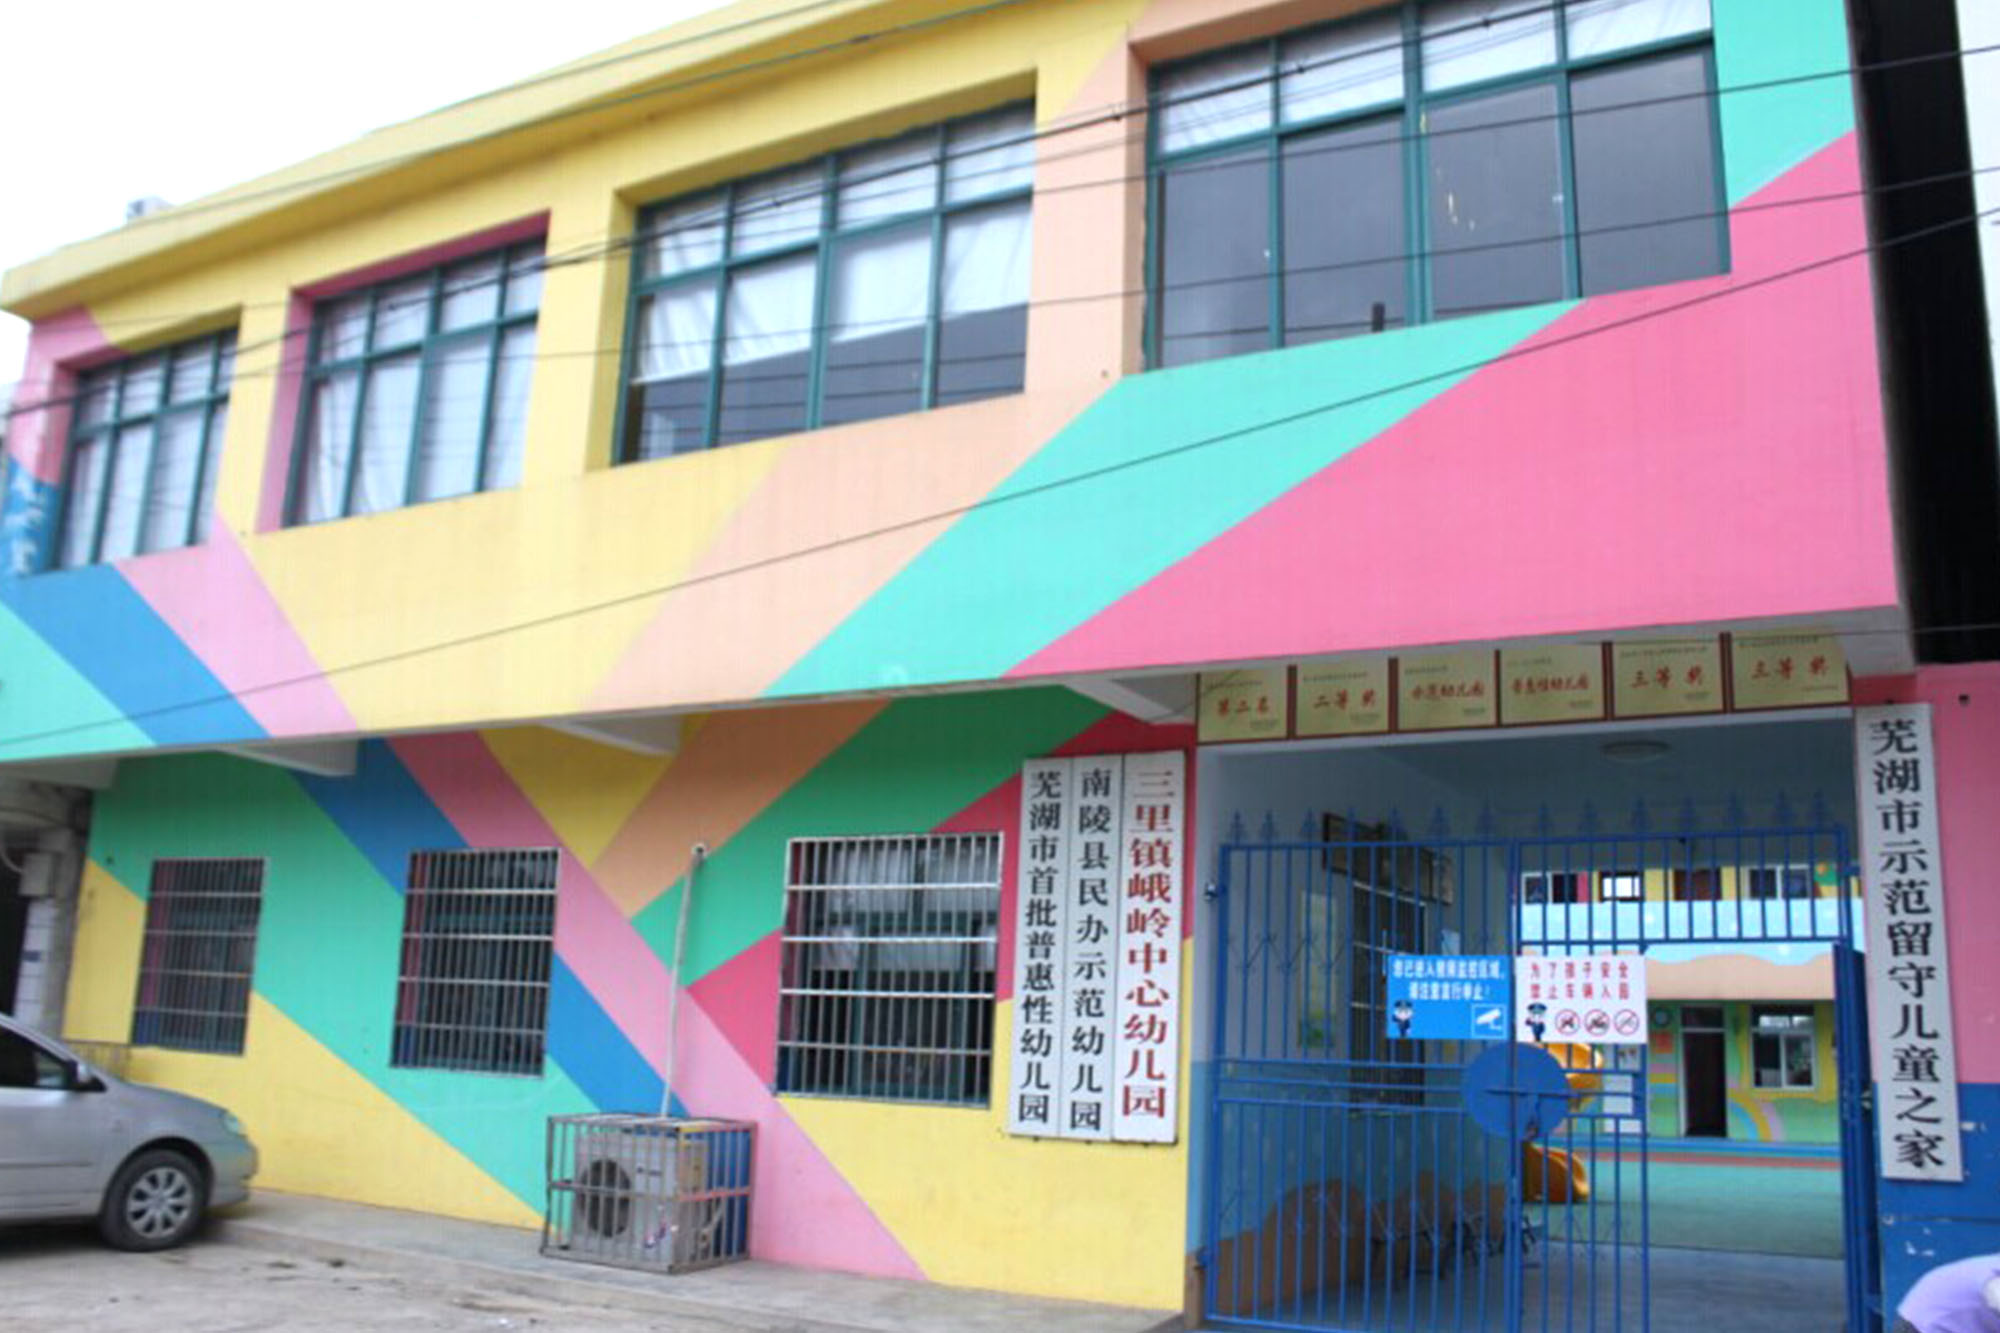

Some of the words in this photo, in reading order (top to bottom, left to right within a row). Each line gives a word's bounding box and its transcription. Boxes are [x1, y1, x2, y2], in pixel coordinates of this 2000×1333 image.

[1018, 770, 1062, 1124] 芜湖市首批普惠性幼儿园
[1069, 768, 1112, 1131] 南陵县民办示范幼儿园
[1122, 769, 1176, 1119] 三里镇峨岭中心幼儿园
[1530, 961, 1629, 979] 为了孩子安全
[1868, 719, 1946, 1169] 芜湖市示范留守儿童之家
